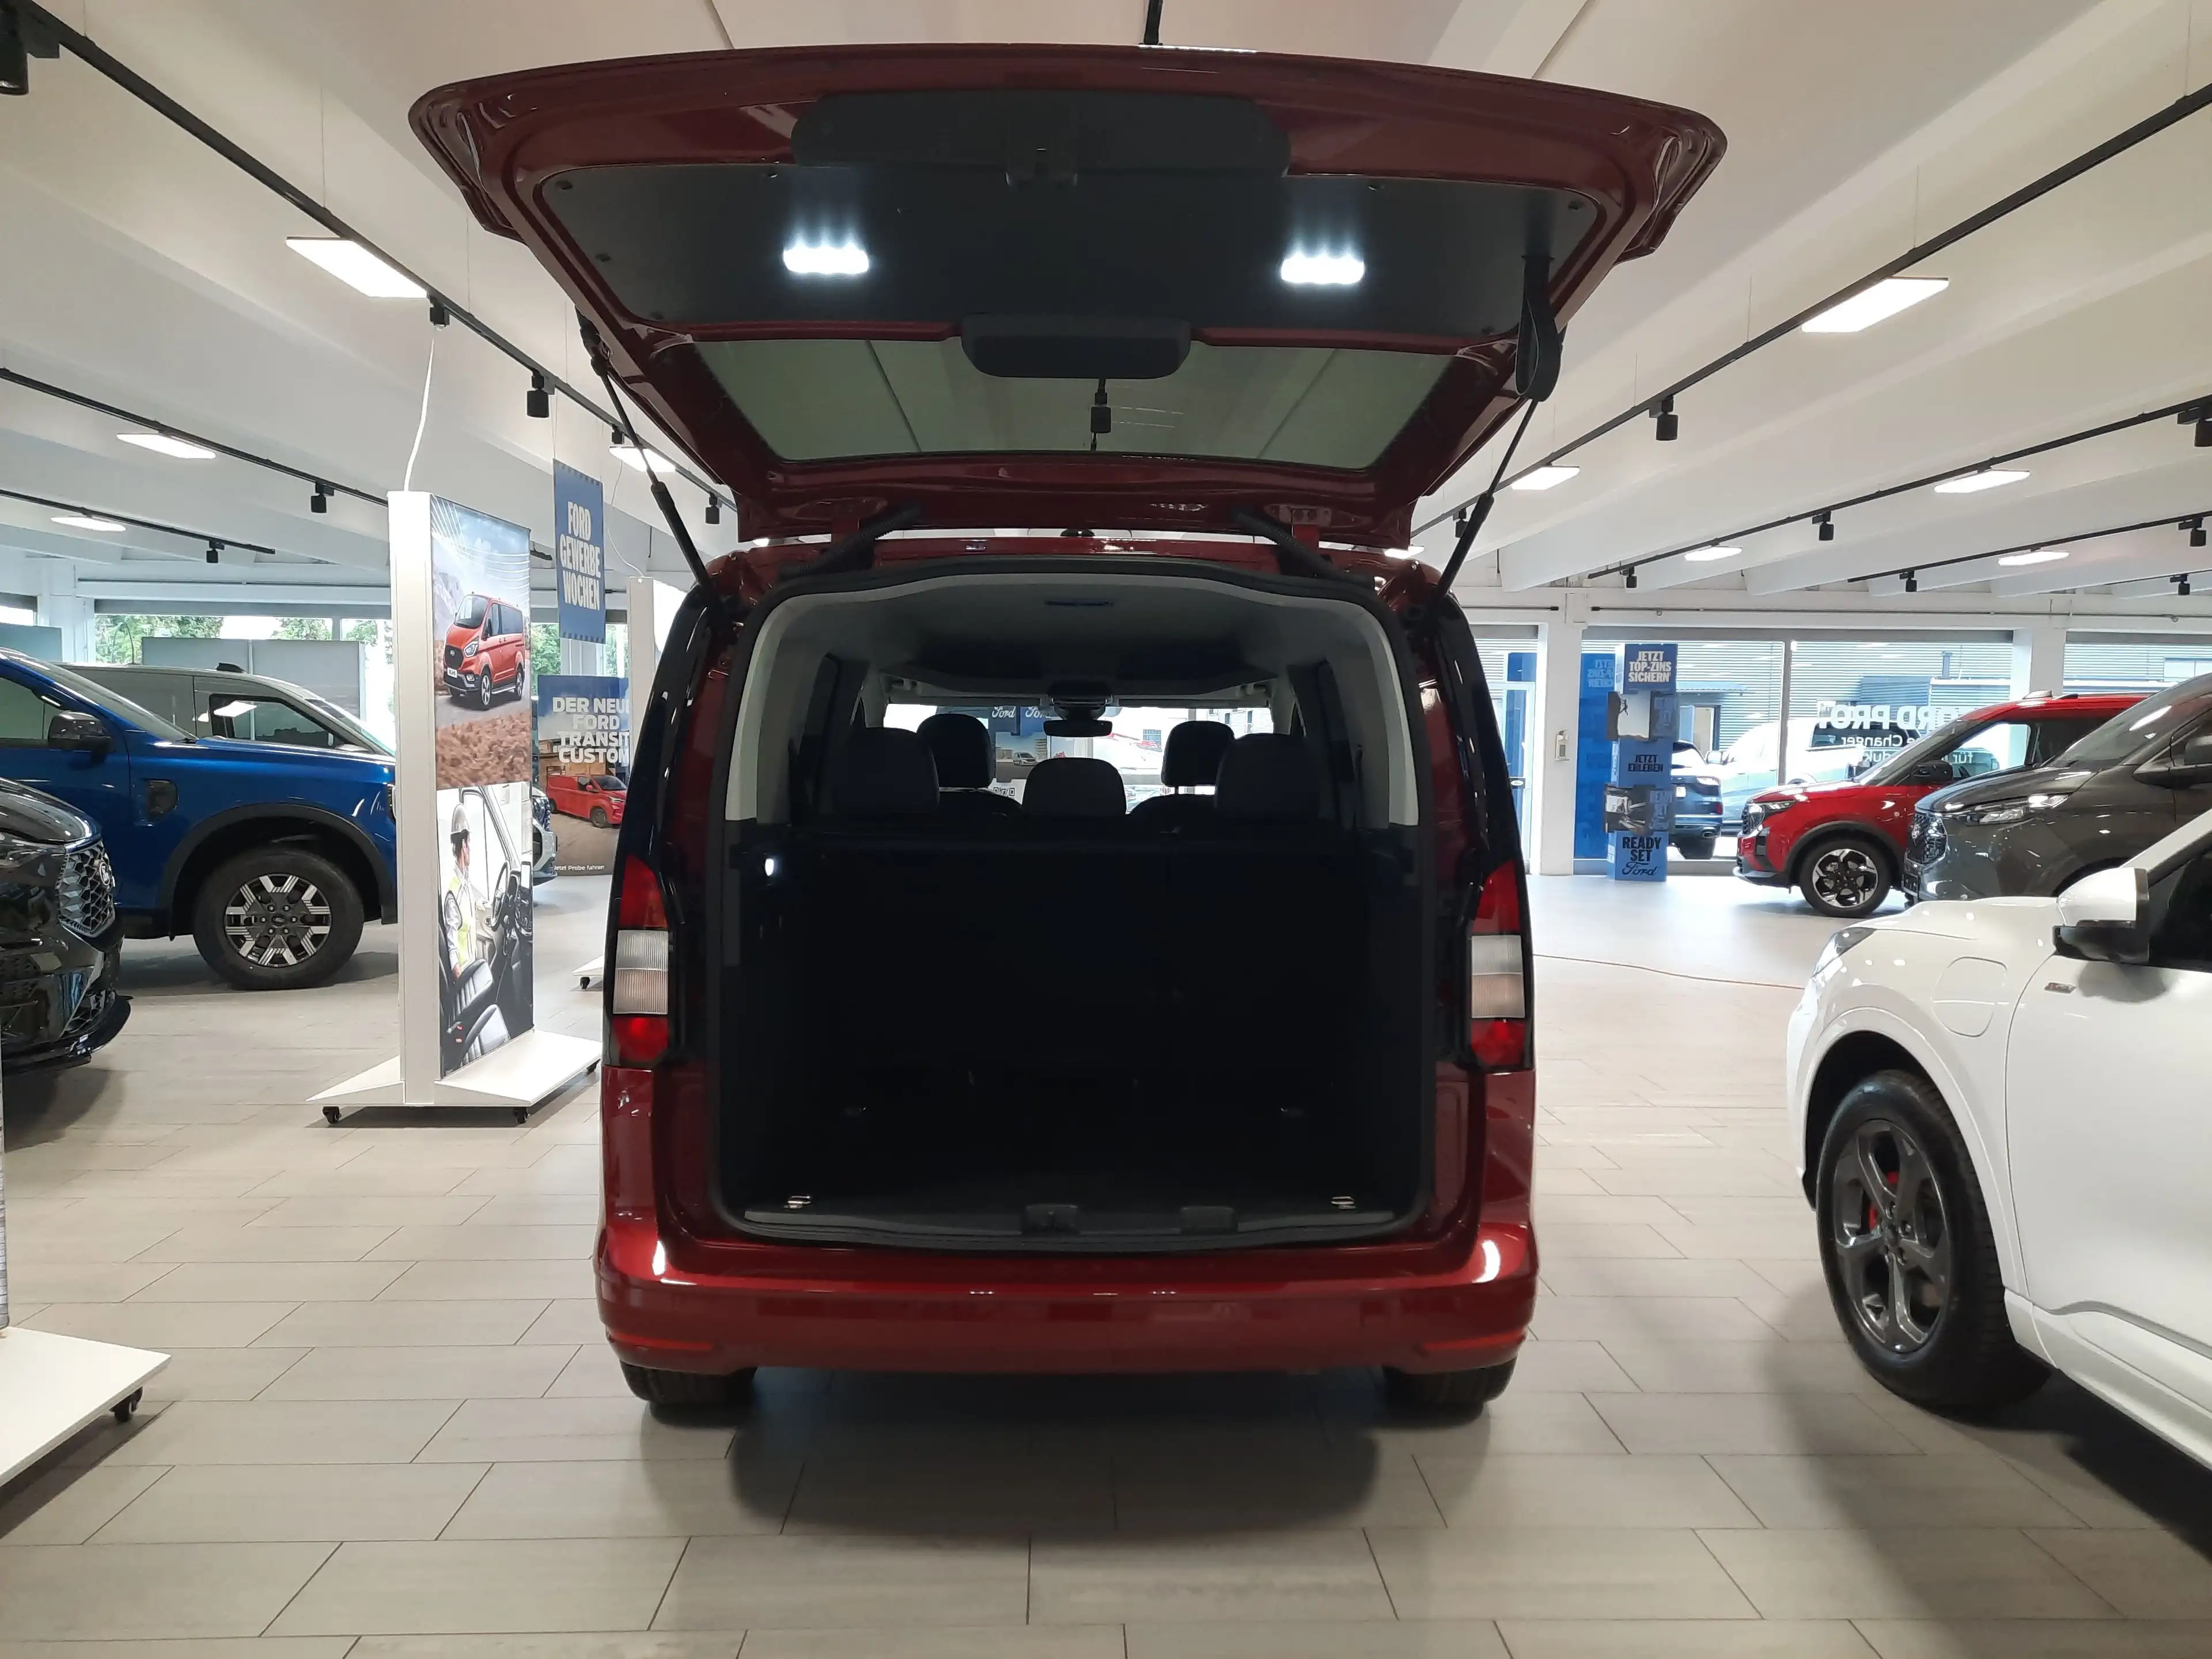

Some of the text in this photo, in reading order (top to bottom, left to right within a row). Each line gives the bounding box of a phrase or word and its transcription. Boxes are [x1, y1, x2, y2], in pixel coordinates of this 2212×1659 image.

[567, 501, 591, 541] FORD
[560, 533, 601, 578] GEWERBE
[562, 570, 600, 611] WOCHEN
[1638, 651, 1664, 661] JETZT
[1628, 661, 1672, 672] TOP-ZINS
[552, 697, 589, 713] DER
[991, 706, 1016, 718] Ford
[573, 714, 620, 730] FORD
[557, 731, 630, 747] TRANSIT
[1634, 755, 1658, 763] JETZT
[1622, 836, 1662, 849] READY
[1630, 849, 1653, 862] SET
[1622, 861, 1658, 876] Ford
